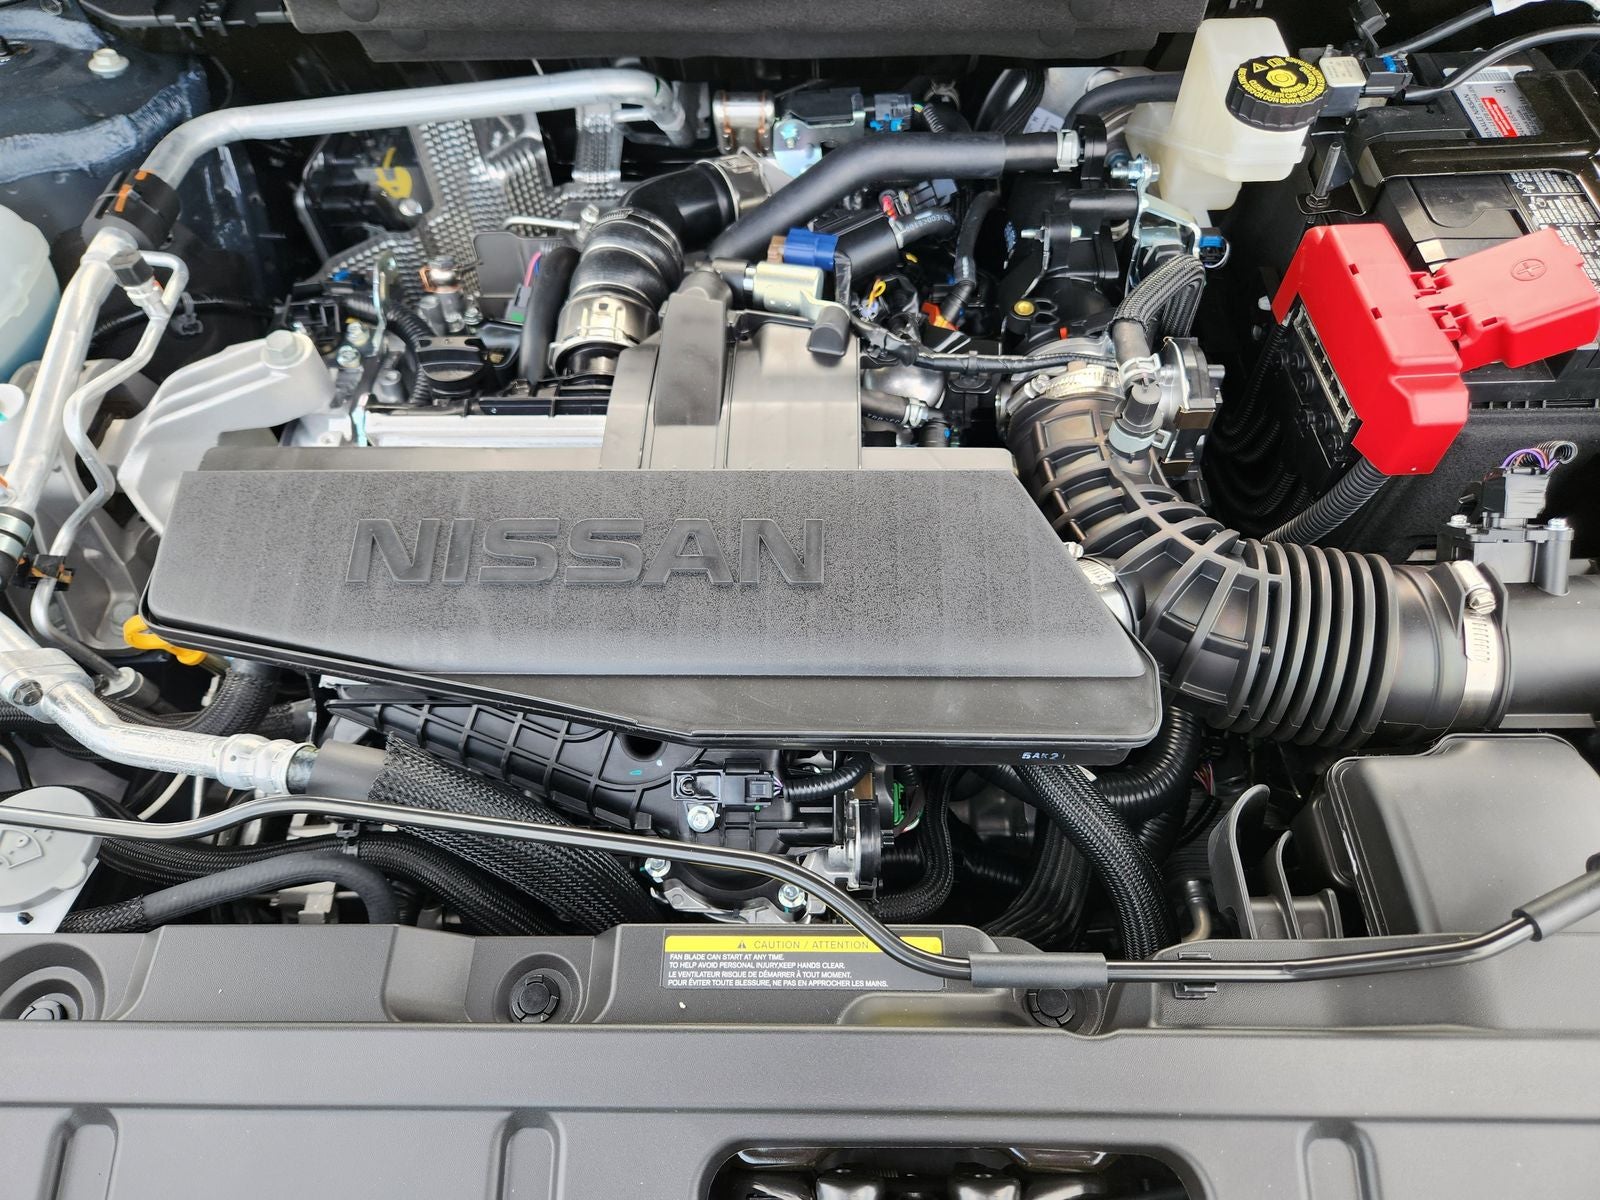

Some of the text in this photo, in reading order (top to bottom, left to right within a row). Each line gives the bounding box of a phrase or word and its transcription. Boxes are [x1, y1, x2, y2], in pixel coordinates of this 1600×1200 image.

[345, 518, 824, 585] NISSAN
[754, 940, 800, 949] CAUTION
[812, 940, 869, 949] ATTENTION
[759, 970, 795, 978] DÉMARRER
[796, 970, 801, 978] À
[689, 978, 711, 986] ÉVITER
